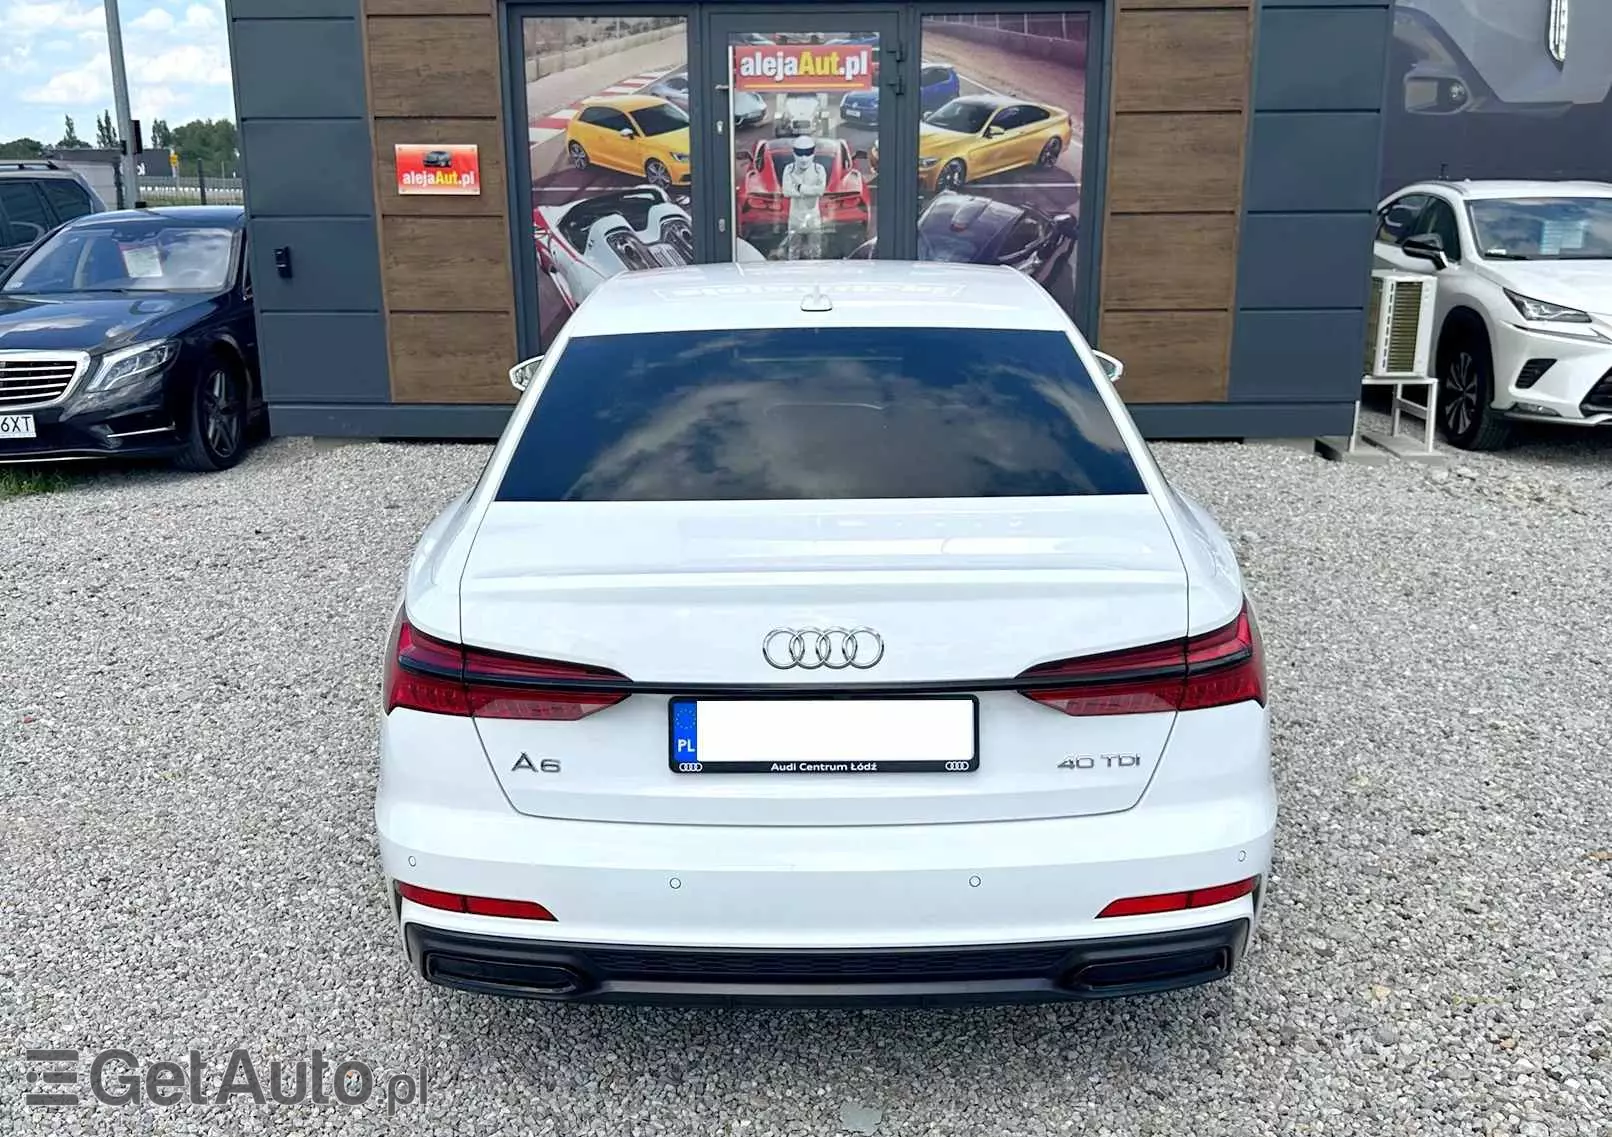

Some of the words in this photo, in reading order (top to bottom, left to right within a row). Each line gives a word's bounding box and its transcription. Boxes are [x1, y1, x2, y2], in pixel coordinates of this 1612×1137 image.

[740, 51, 868, 82] alejaAut.pl
[402, 170, 475, 188] alejaAut.pl
[677, 739, 695, 753] PL
[511, 751, 562, 773] A6
[770, 762, 797, 772] Audi
[799, 762, 847, 772] Centrum
[1057, 756, 1094, 770] 40
[1100, 753, 1140, 768] TDI
